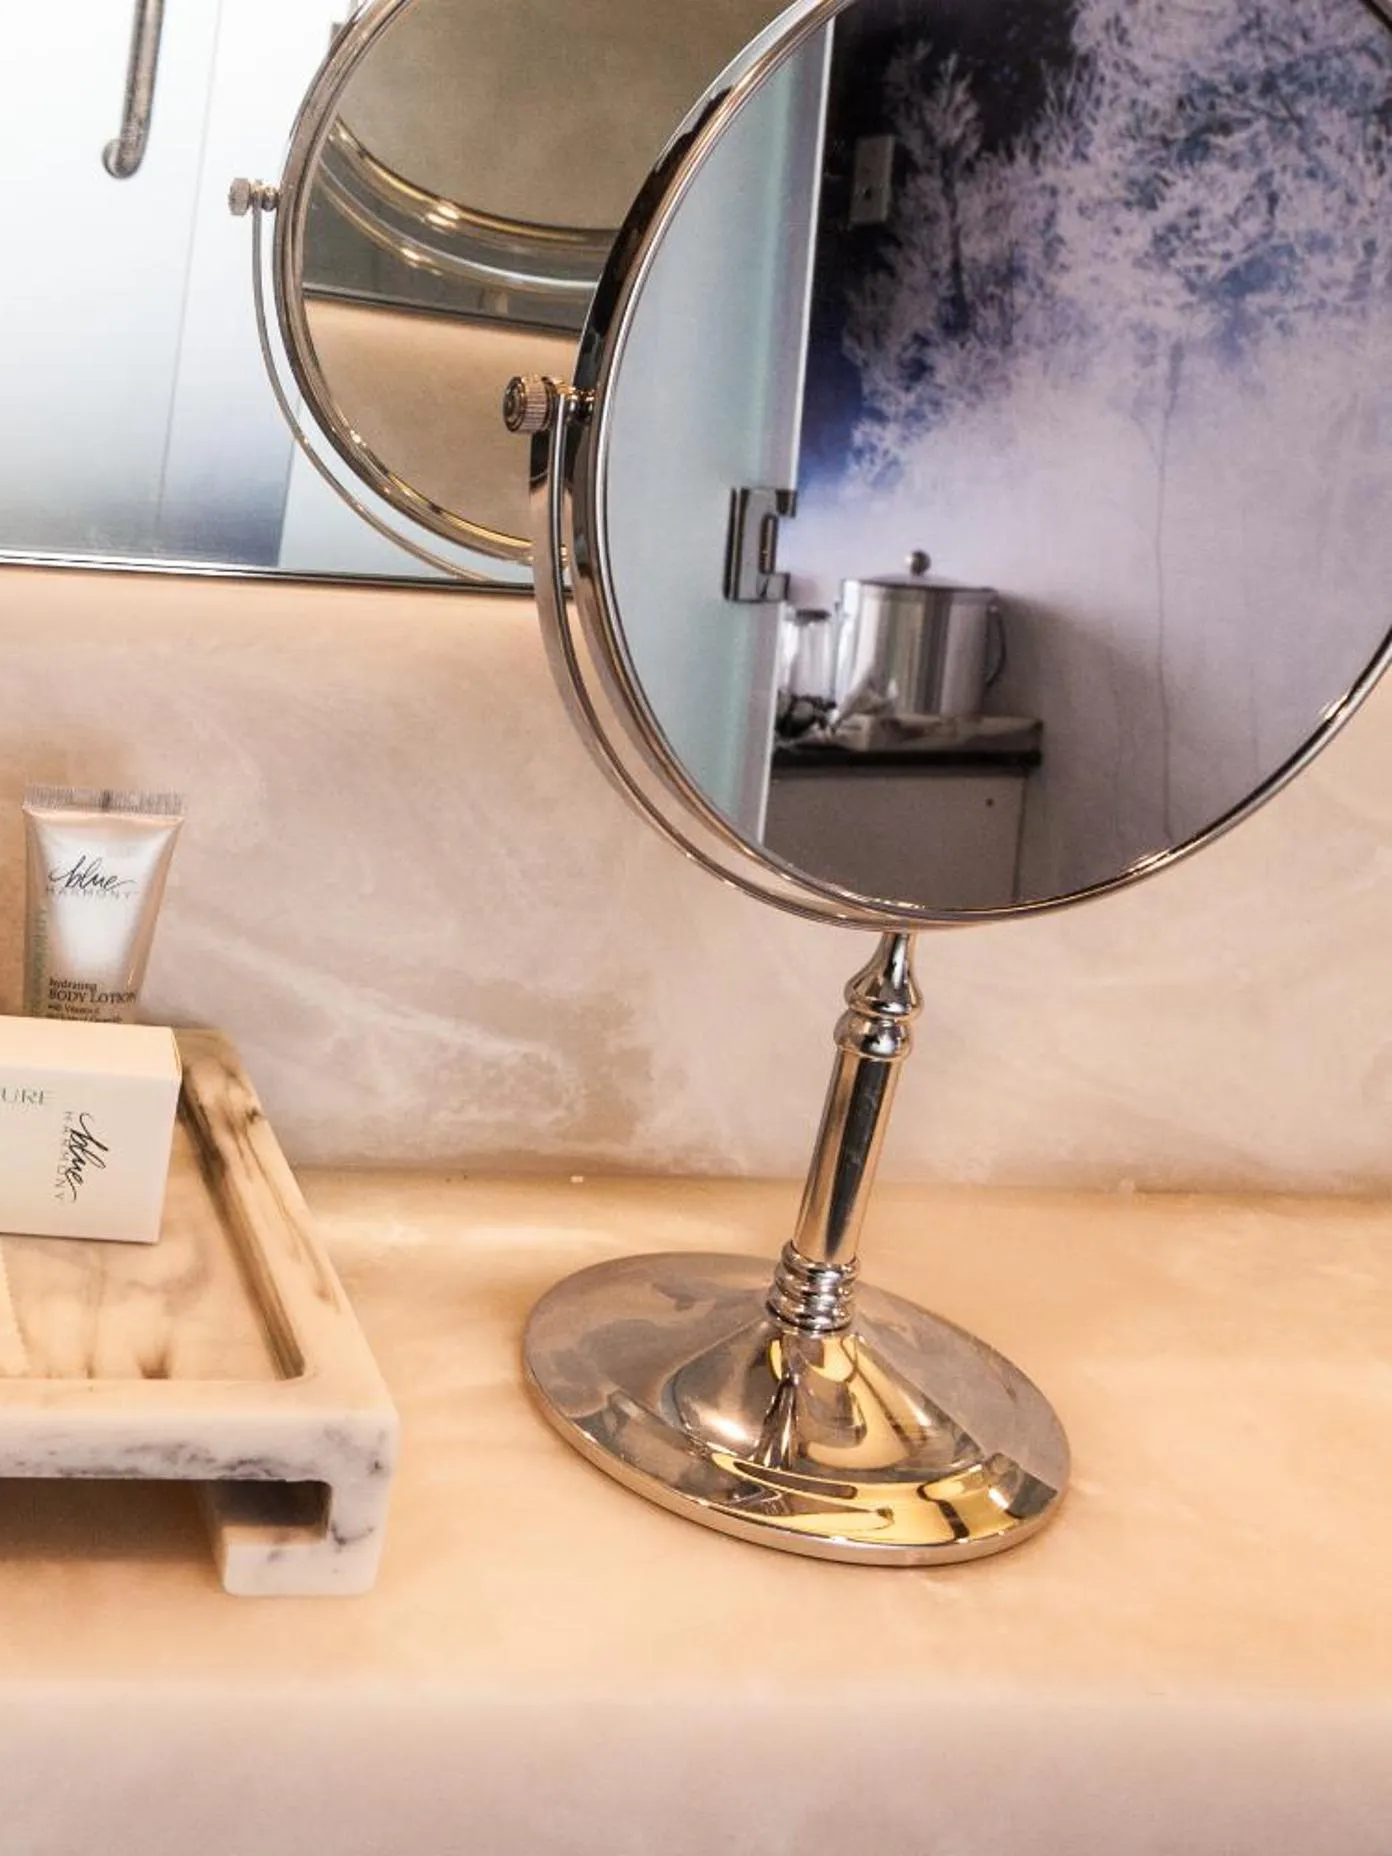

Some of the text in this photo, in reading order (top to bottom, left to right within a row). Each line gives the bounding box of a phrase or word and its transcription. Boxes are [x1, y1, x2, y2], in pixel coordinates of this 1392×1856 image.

[48, 855, 136, 890] blue
[46, 886, 131, 899] HARMONY
[49, 976, 97, 992] hydrating
[49, 988, 87, 1002] BODY
[65, 1112, 109, 1203] blue
